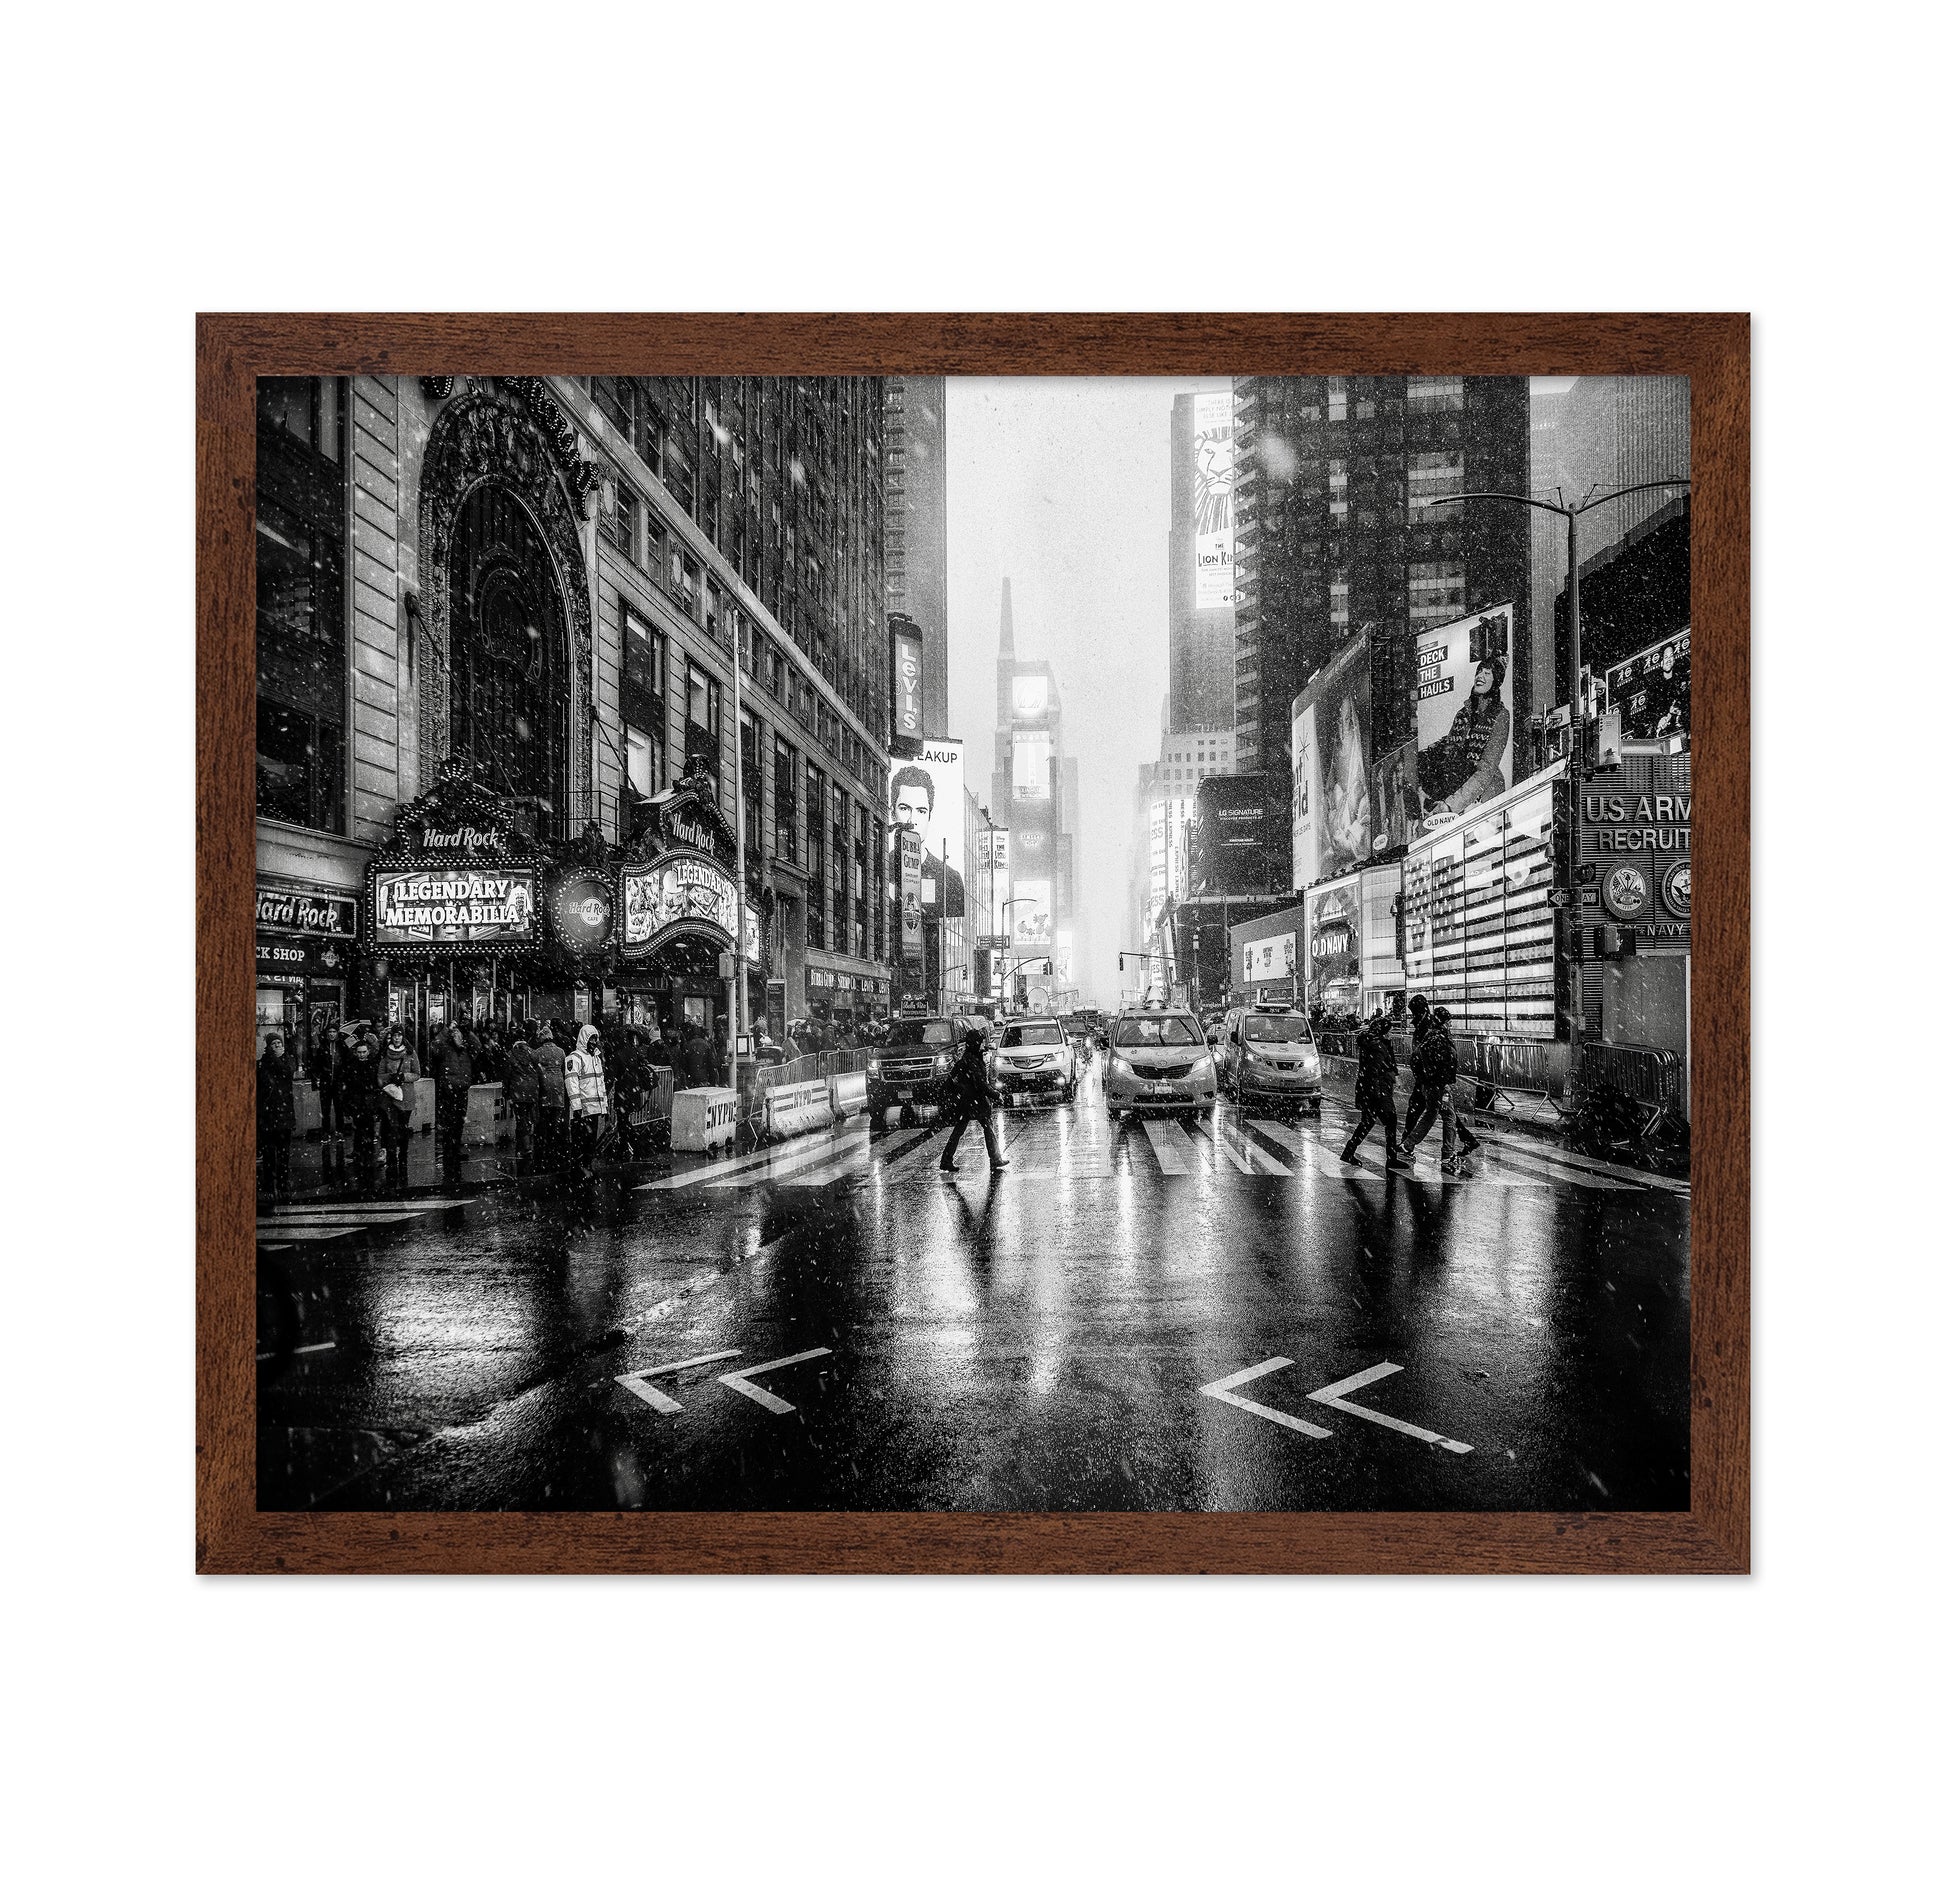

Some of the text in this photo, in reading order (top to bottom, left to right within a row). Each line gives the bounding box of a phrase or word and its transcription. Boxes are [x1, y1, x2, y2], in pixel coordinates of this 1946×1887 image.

[1198, 552, 1218, 567] LION
[1420, 648, 1445, 668] DECK
[1420, 666, 1438, 682] THE
[1420, 679, 1451, 699] HAULS
[1228, 808, 1263, 816] SIGNATURE
[1427, 815, 1456, 827] OLD NAVY
[423, 826, 499, 850] Hard Rock
[673, 812, 715, 856] Hard Rock
[1600, 828, 1691, 850] RECRUIT
[398, 878, 509, 902] LEGENDARY
[1555, 892, 1594, 904] ONE AY
[297, 898, 342, 932] Rock
[385, 904, 520, 927] MEMORABILIA
[569, 901, 610, 917] Hard Rock
[1647, 923, 1684, 936] NAVY
[1326, 933, 1349, 955] NAVY
[273, 947, 305, 962] SHOP
[792, 1088, 812, 1109] NYPD
[711, 1102, 734, 1129] NYPD
